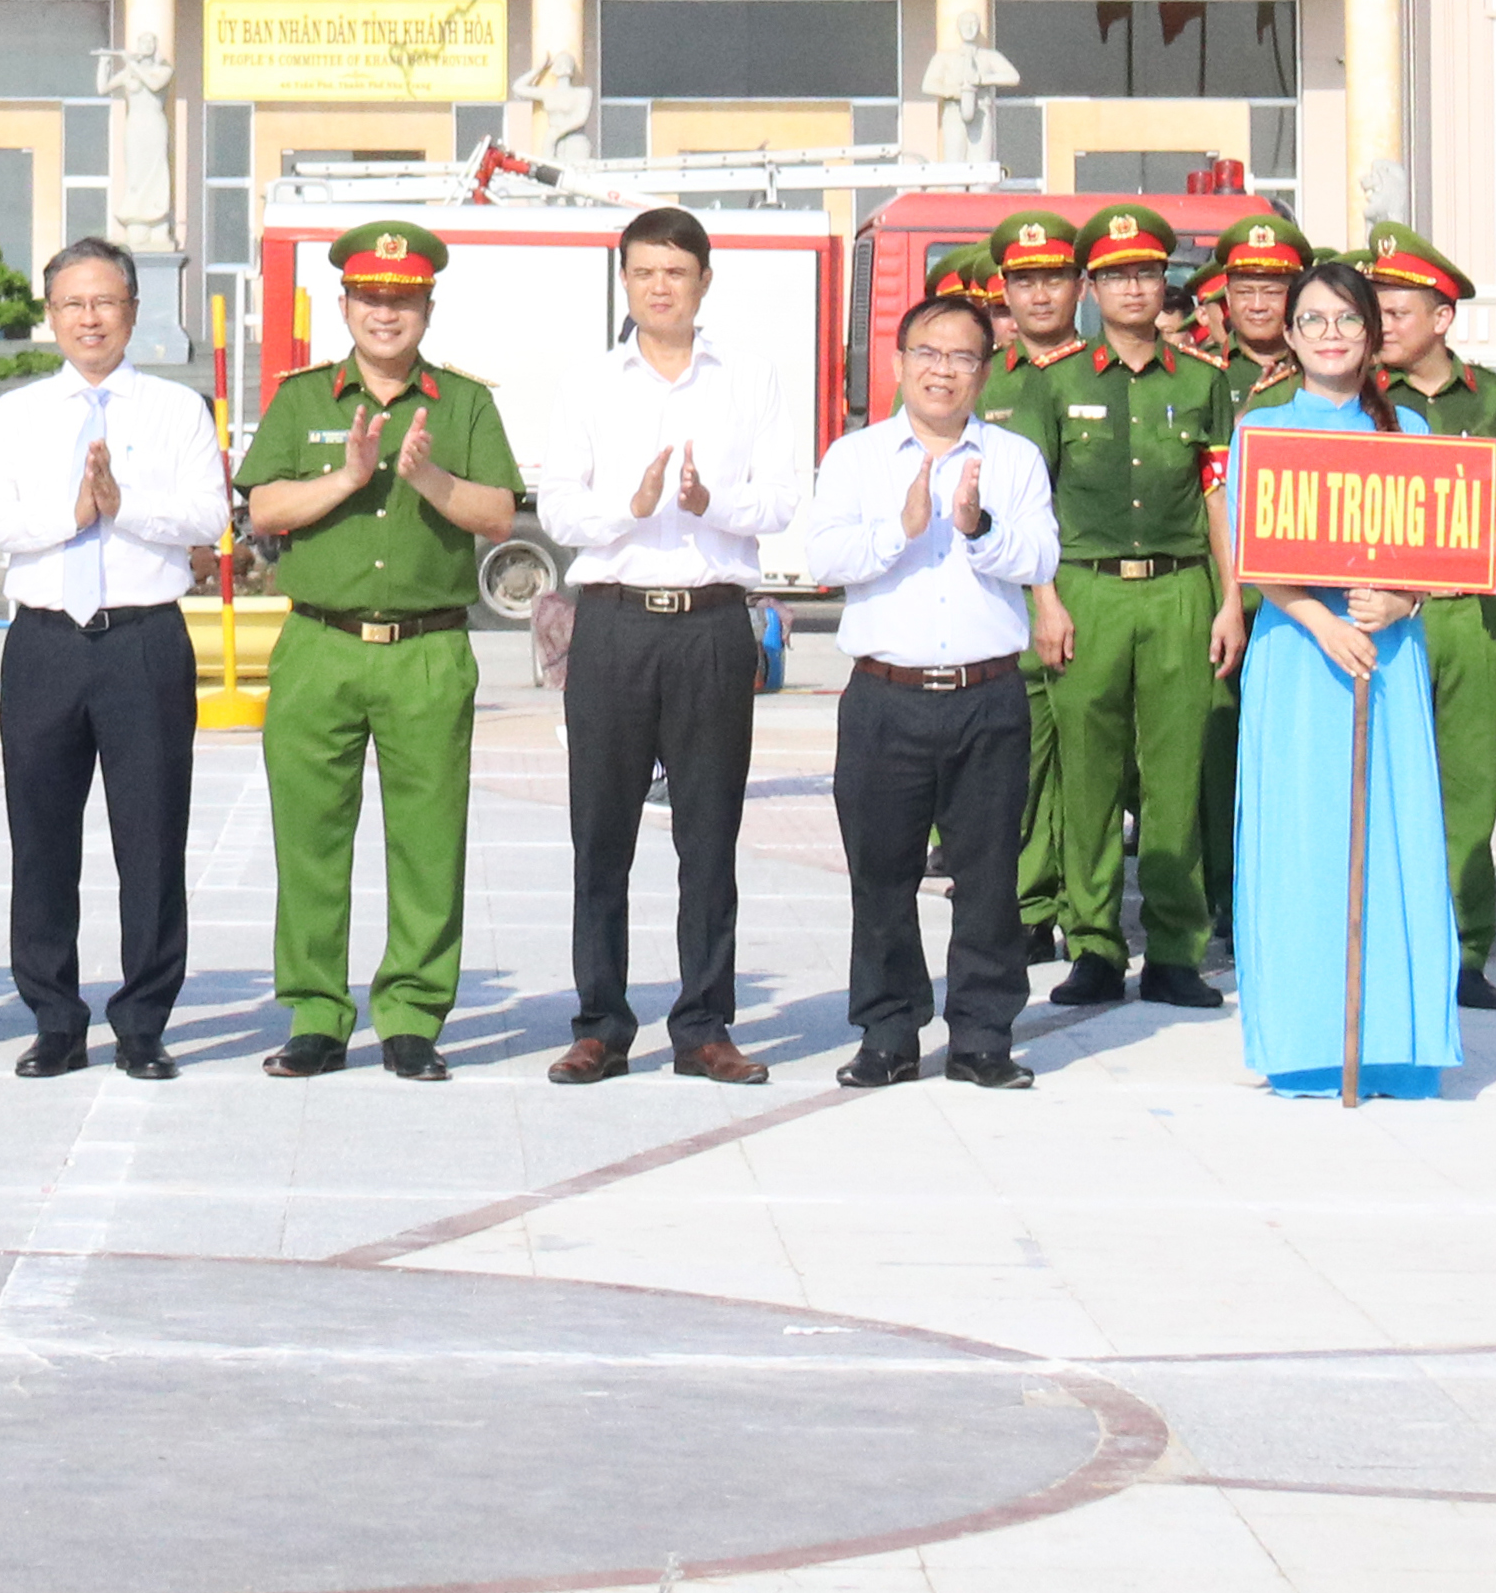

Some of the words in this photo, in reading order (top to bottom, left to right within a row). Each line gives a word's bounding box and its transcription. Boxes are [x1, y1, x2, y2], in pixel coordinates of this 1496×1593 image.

[242, 18, 274, 45] BAN
[278, 12, 322, 45] NHÂN
[326, 12, 357, 45] DÂN
[362, 9, 399, 45] TỈNH
[403, 11, 459, 45] KHÁNH
[463, 12, 495, 45] HÒA
[278, 53, 343, 67] COMMITTEE
[346, 53, 361, 67] OF
[1255, 468, 1320, 542] BAN
[1326, 471, 1427, 561] TRỌNG
[1433, 463, 1482, 549] TÀI
